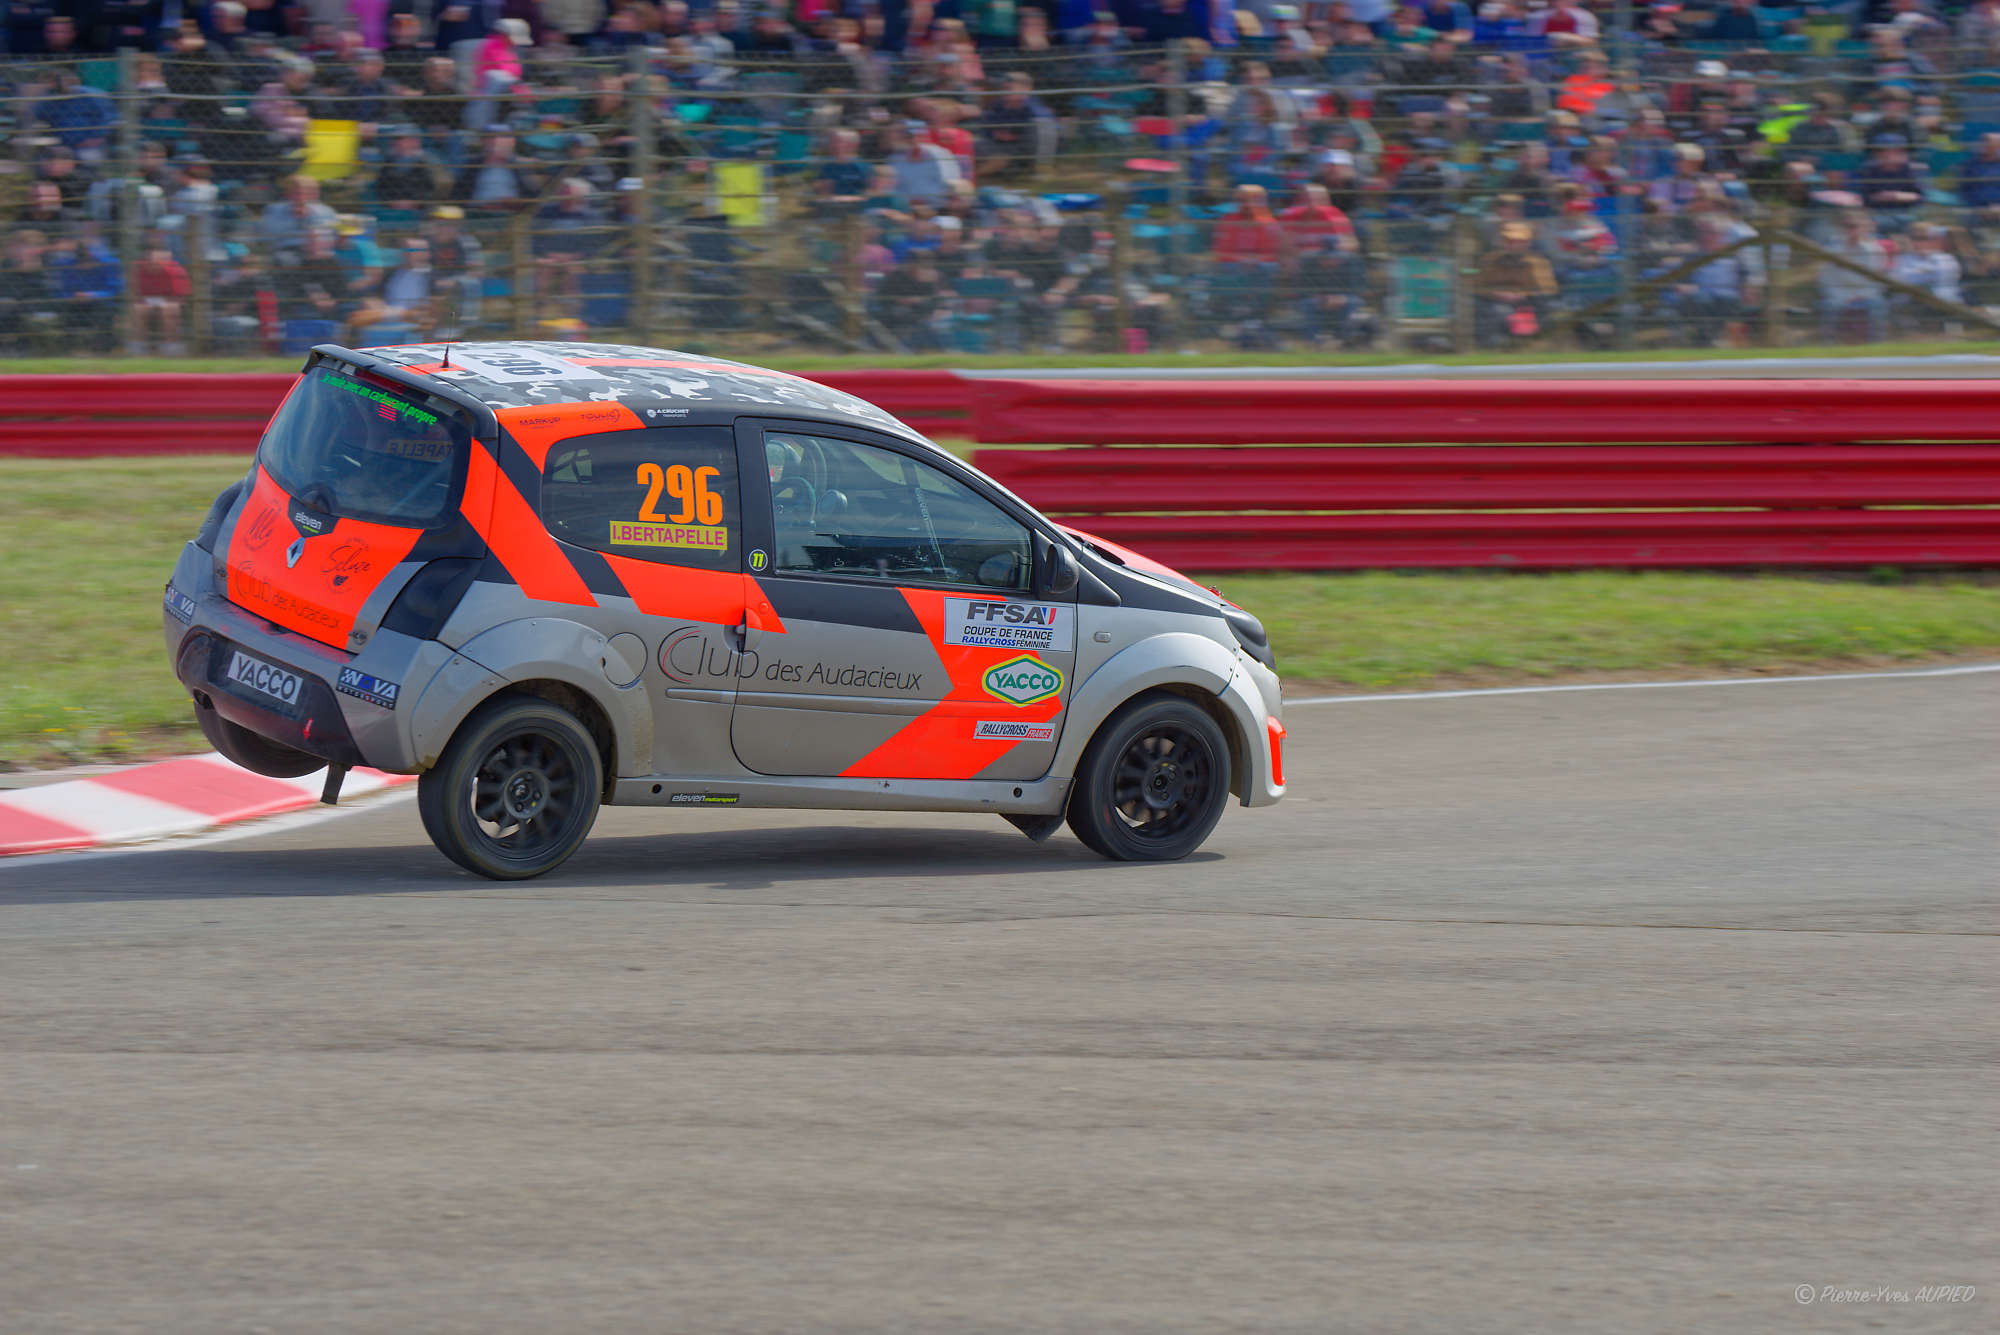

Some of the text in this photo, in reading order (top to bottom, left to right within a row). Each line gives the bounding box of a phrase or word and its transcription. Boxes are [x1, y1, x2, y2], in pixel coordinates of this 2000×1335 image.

[461, 352, 563, 377] 296
[368, 391, 410, 412] carburant
[404, 405, 438, 425] propre
[637, 463, 723, 525] 296
[295, 511, 322, 530] eleven
[613, 525, 725, 546] I.BERTAPELLE
[753, 553, 764, 567] 11
[967, 602, 1046, 625] FFSA
[961, 636, 1050, 649] RALLYCROSS FÉMININE
[963, 625, 1053, 641] COUPE DE FRANCE
[657, 626, 922, 691] Club des Audacieux
[235, 653, 297, 701] YACCO
[994, 673, 1055, 690] YACCO
[980, 724, 1051, 739] RALLYCROSS FRANCE
[671, 794, 706, 802] eleven
